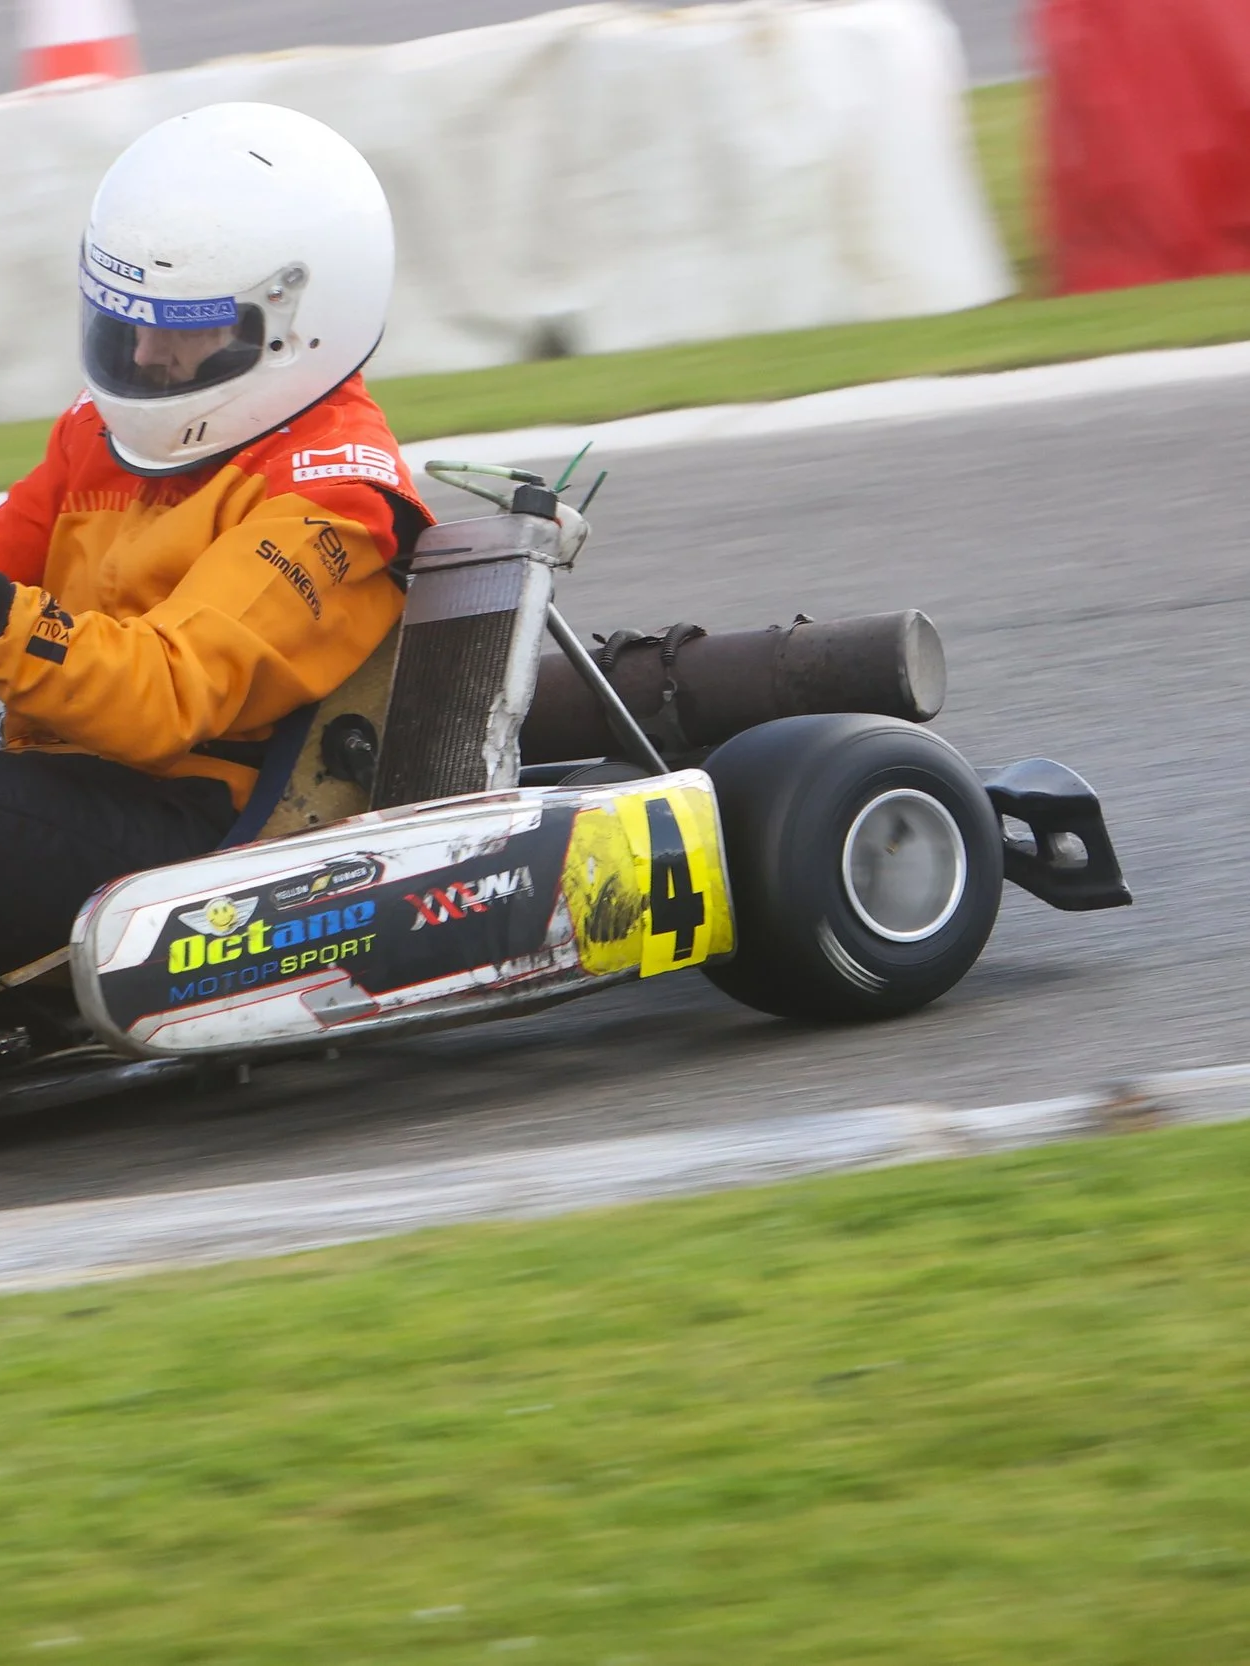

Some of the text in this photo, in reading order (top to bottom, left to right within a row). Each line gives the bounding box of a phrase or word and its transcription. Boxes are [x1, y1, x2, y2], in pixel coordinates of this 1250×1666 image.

[300, 465, 394, 481] RACEWEAR
[645, 797, 705, 962] 4
[168, 899, 376, 975] Octane
